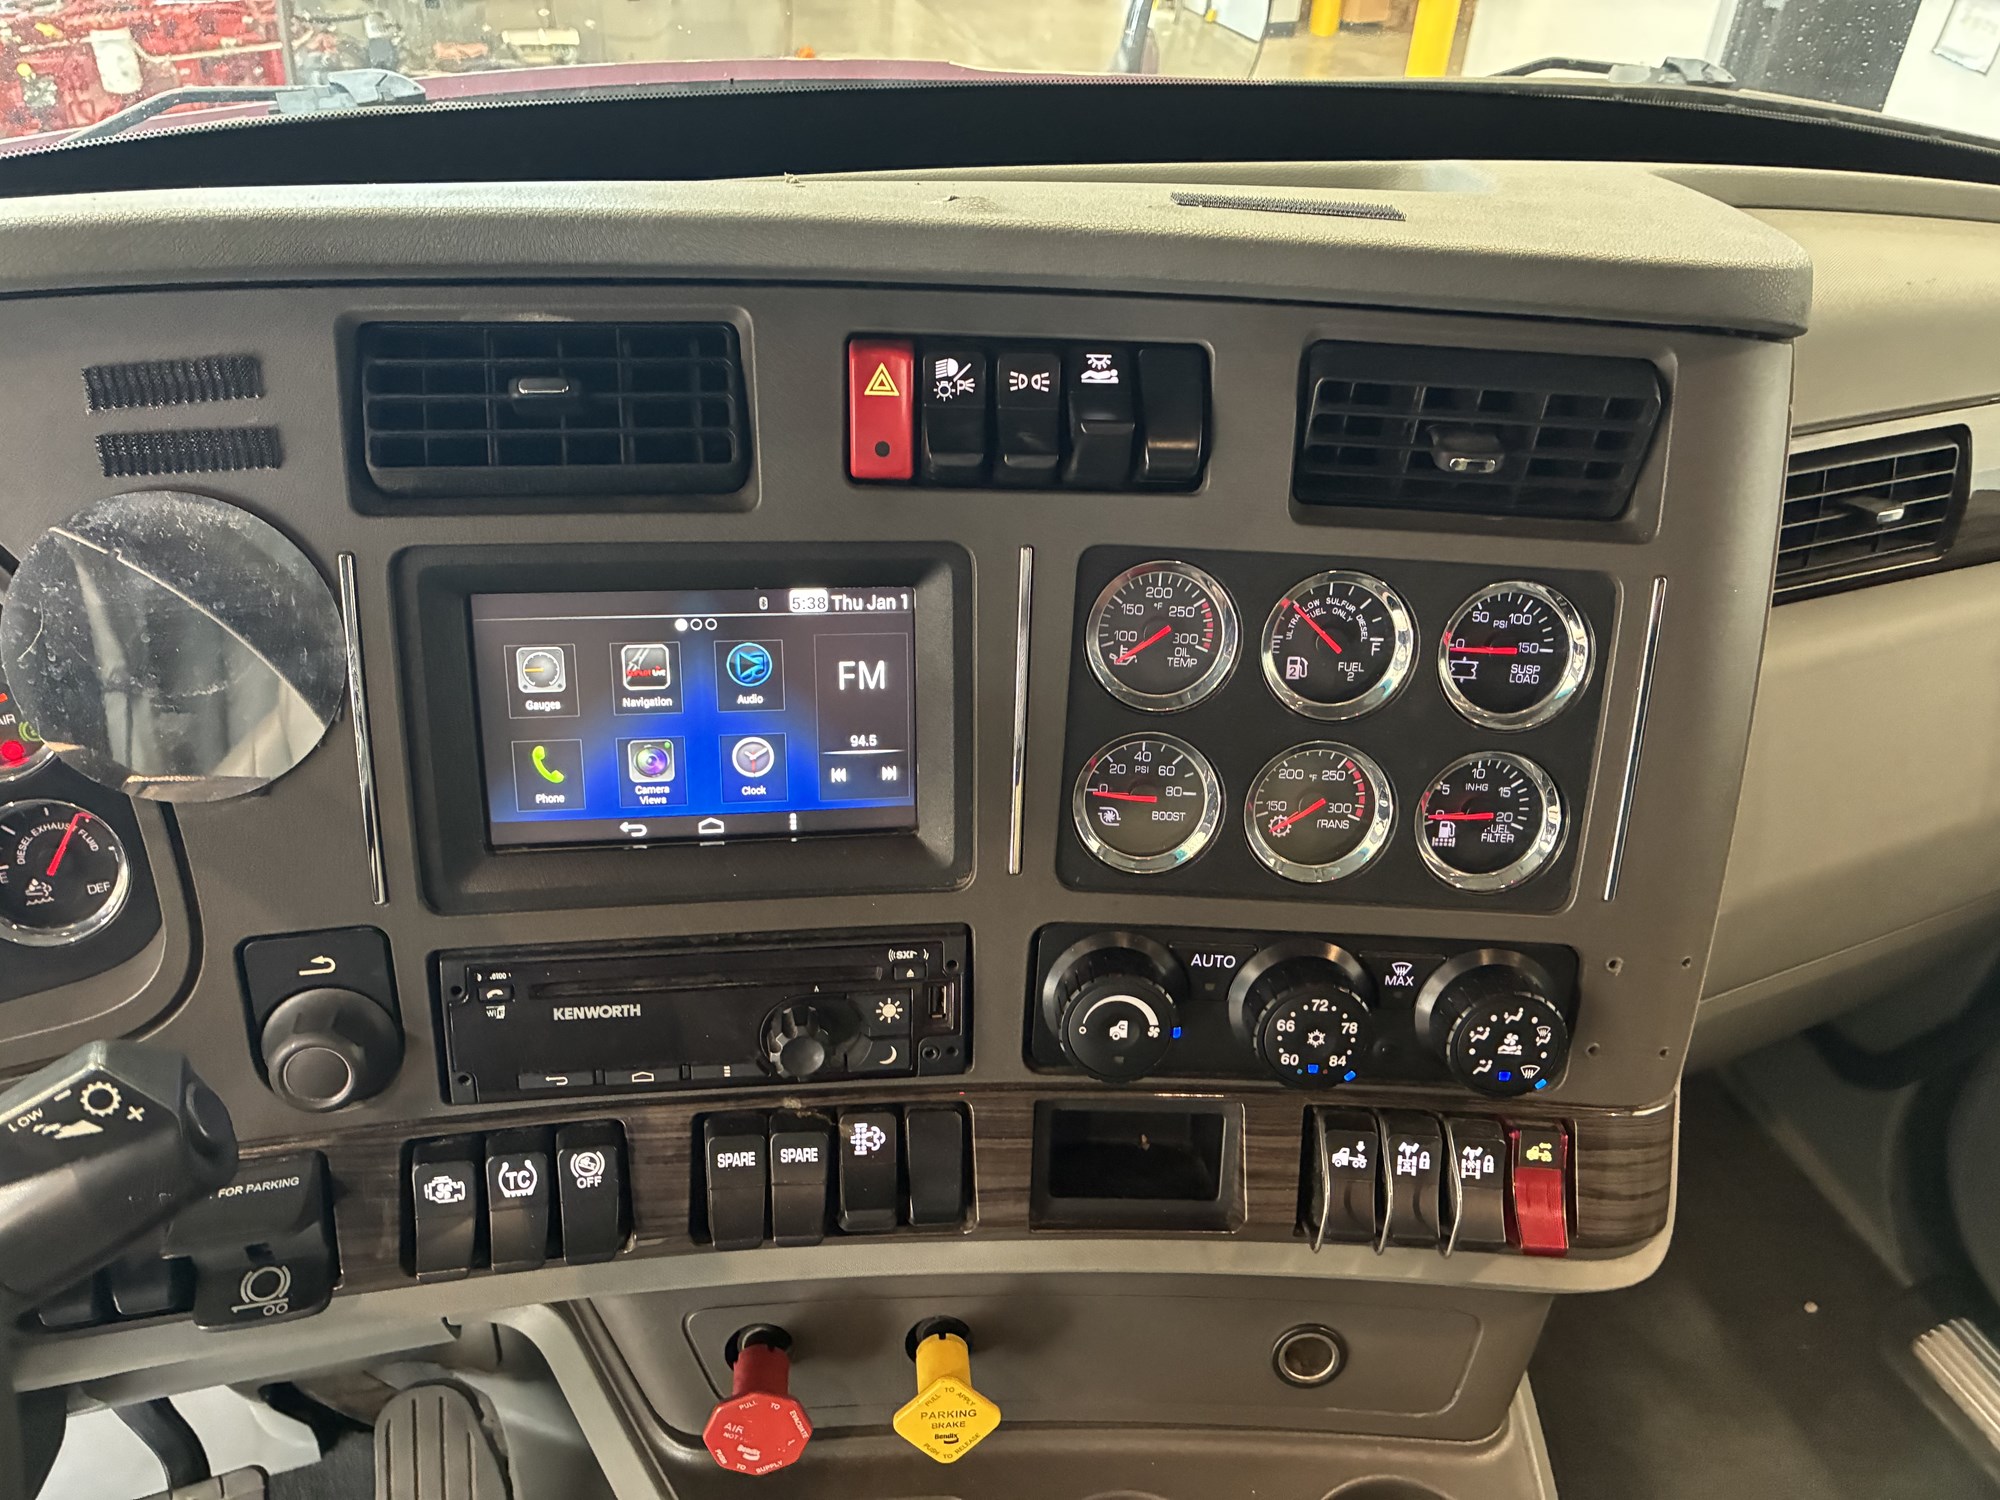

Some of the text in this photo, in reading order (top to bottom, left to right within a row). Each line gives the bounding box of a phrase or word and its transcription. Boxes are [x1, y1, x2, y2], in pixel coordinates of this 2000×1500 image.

[1145, 586, 1173, 599] 200
[792, 594, 908, 611] 5:38 Thu Jan 1
[1121, 603, 1144, 616] 150
[1168, 606, 1195, 618] 250
[1332, 608, 1353, 623] ONLY
[1303, 599, 1320, 612] LOW
[1326, 597, 1356, 613] SULFUR
[1356, 614, 1368, 642] DIESEL
[1472, 611, 1490, 623] 50
[1508, 613, 1532, 626] 100
[1493, 619, 1508, 629] PSI
[1113, 630, 1138, 643] 100
[1172, 633, 1199, 645] 300
[1174, 647, 1190, 658] OIL
[1371, 642, 1381, 657] F
[1518, 642, 1540, 654] 150
[1166, 657, 1198, 668] TEMP
[1338, 661, 1365, 673] FUEL
[1510, 663, 1541, 675] SUSP
[838, 660, 886, 691] FM
[1346, 672, 1355, 682] 2
[1509, 674, 1540, 685] LOAD
[622, 696, 673, 709] Navigation
[737, 692, 763, 704] Audio
[525, 698, 561, 712] Gauges
[850, 734, 877, 746] 94.5
[1134, 751, 1152, 762] 40
[1109, 763, 1126, 775] 20
[1134, 765, 1150, 774] PSI
[1158, 766, 1176, 777] 60
[1278, 769, 1304, 781] 200
[1471, 768, 1486, 780] 10
[1321, 770, 1346, 782] 250
[635, 783, 670, 796] Camera
[741, 784, 767, 796] Clock
[1099, 783, 1109, 794] 0
[1165, 786, 1183, 798] 80
[1441, 784, 1451, 796] 5
[1498, 787, 1512, 798] 15
[535, 791, 565, 805] Phone
[639, 793, 668, 806] Views
[1266, 800, 1287, 812] 150
[1327, 803, 1352, 814] 300
[1151, 811, 1186, 822] BOOST
[1495, 811, 1514, 823] 20
[1316, 819, 1350, 830] TRANS
[1480, 832, 1515, 844] FILTER
[16, 834, 34, 866] DIESEL
[77, 828, 100, 853] FLUID
[86, 881, 111, 896] DEF
[1190, 952, 1237, 969] AUTO
[1384, 974, 1415, 987] MAX
[1311, 1000, 1329, 1012] 72
[552, 1004, 642, 1021] KENWORTH
[1276, 1020, 1295, 1032] 66
[1340, 1022, 1358, 1034] 78
[1280, 1053, 1299, 1066] 60
[1328, 1055, 1347, 1067] 84
[7, 1107, 45, 1133] LOW
[717, 1151, 756, 1169] SPARE
[779, 1147, 819, 1164] SPARE
[504, 1171, 530, 1191] TC
[576, 1175, 602, 1189] OFF
[217, 1176, 300, 1199] FOR PARKING
[944, 1386, 956, 1394] TO
[770, 1402, 781, 1411] TO
[920, 1408, 977, 1420] PARKING
[723, 1422, 744, 1435] AIR
[931, 1421, 967, 1430] BRAKE
[934, 1432, 959, 1441] Bendix
[954, 1431, 982, 1455] RELEASE
[736, 1463, 747, 1471] TO
[755, 1459, 784, 1475] SUPPLY
